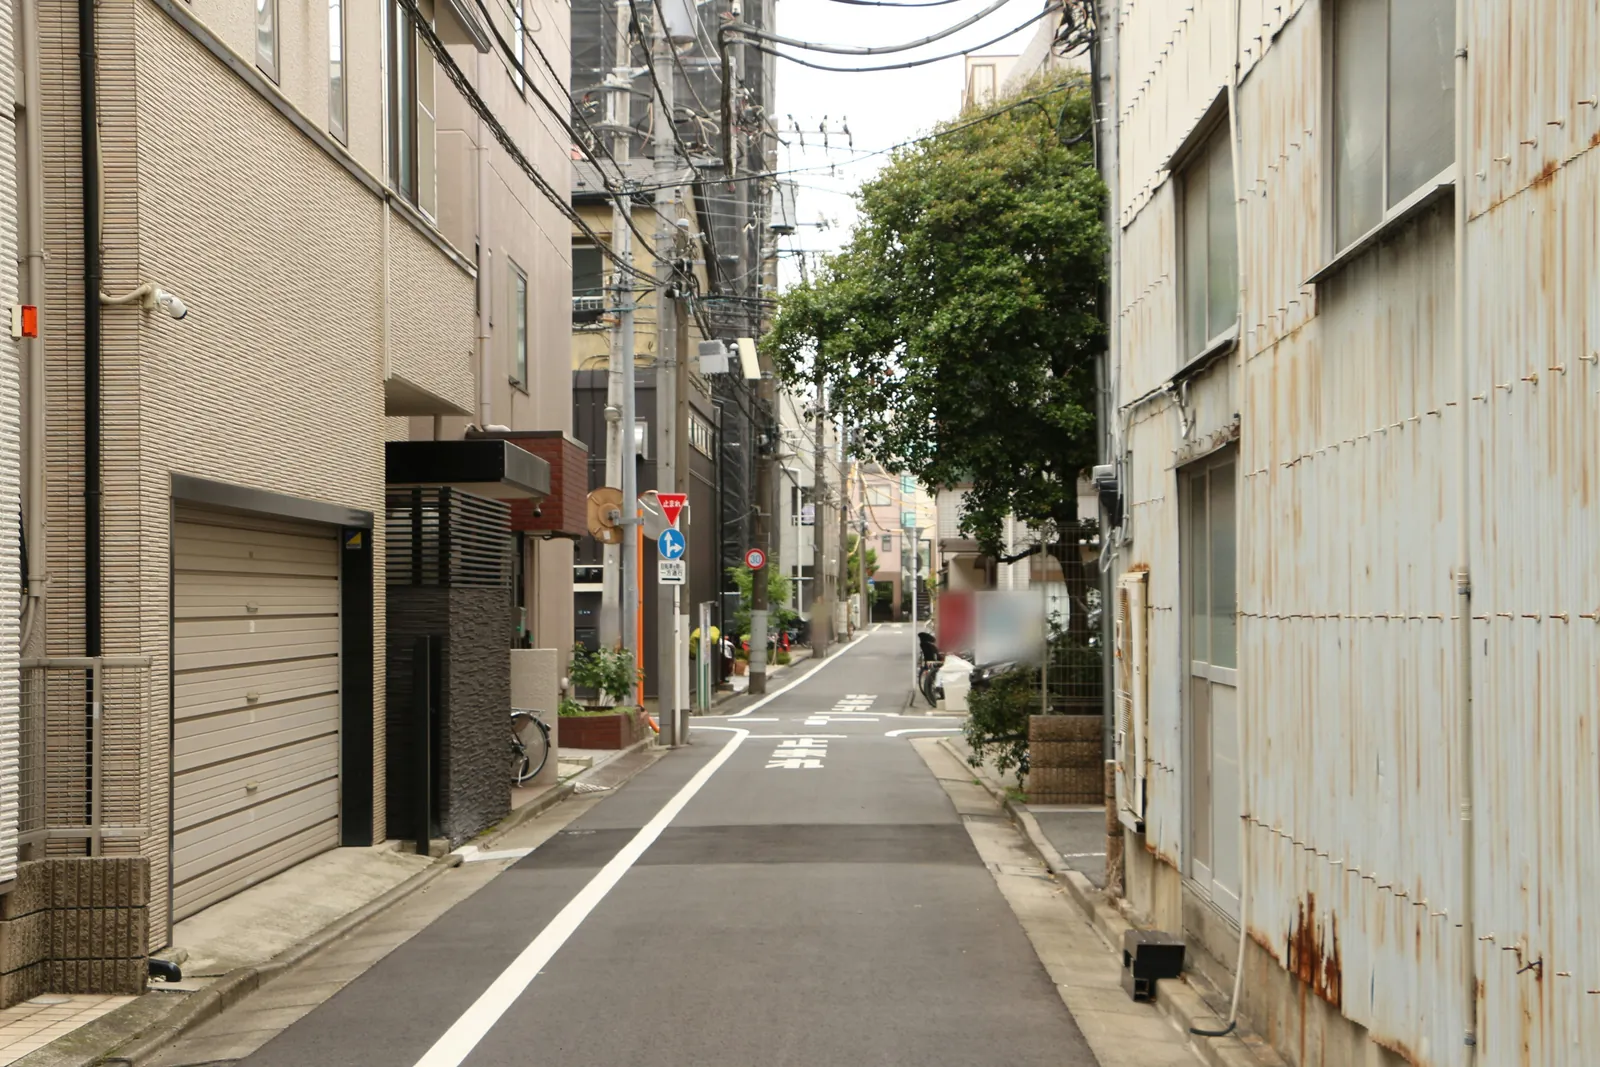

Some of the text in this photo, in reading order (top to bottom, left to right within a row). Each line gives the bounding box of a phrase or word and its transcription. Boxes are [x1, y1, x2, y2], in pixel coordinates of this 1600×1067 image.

[663, 499, 681, 508] 止まれ
[750, 554, 761, 564] 30
